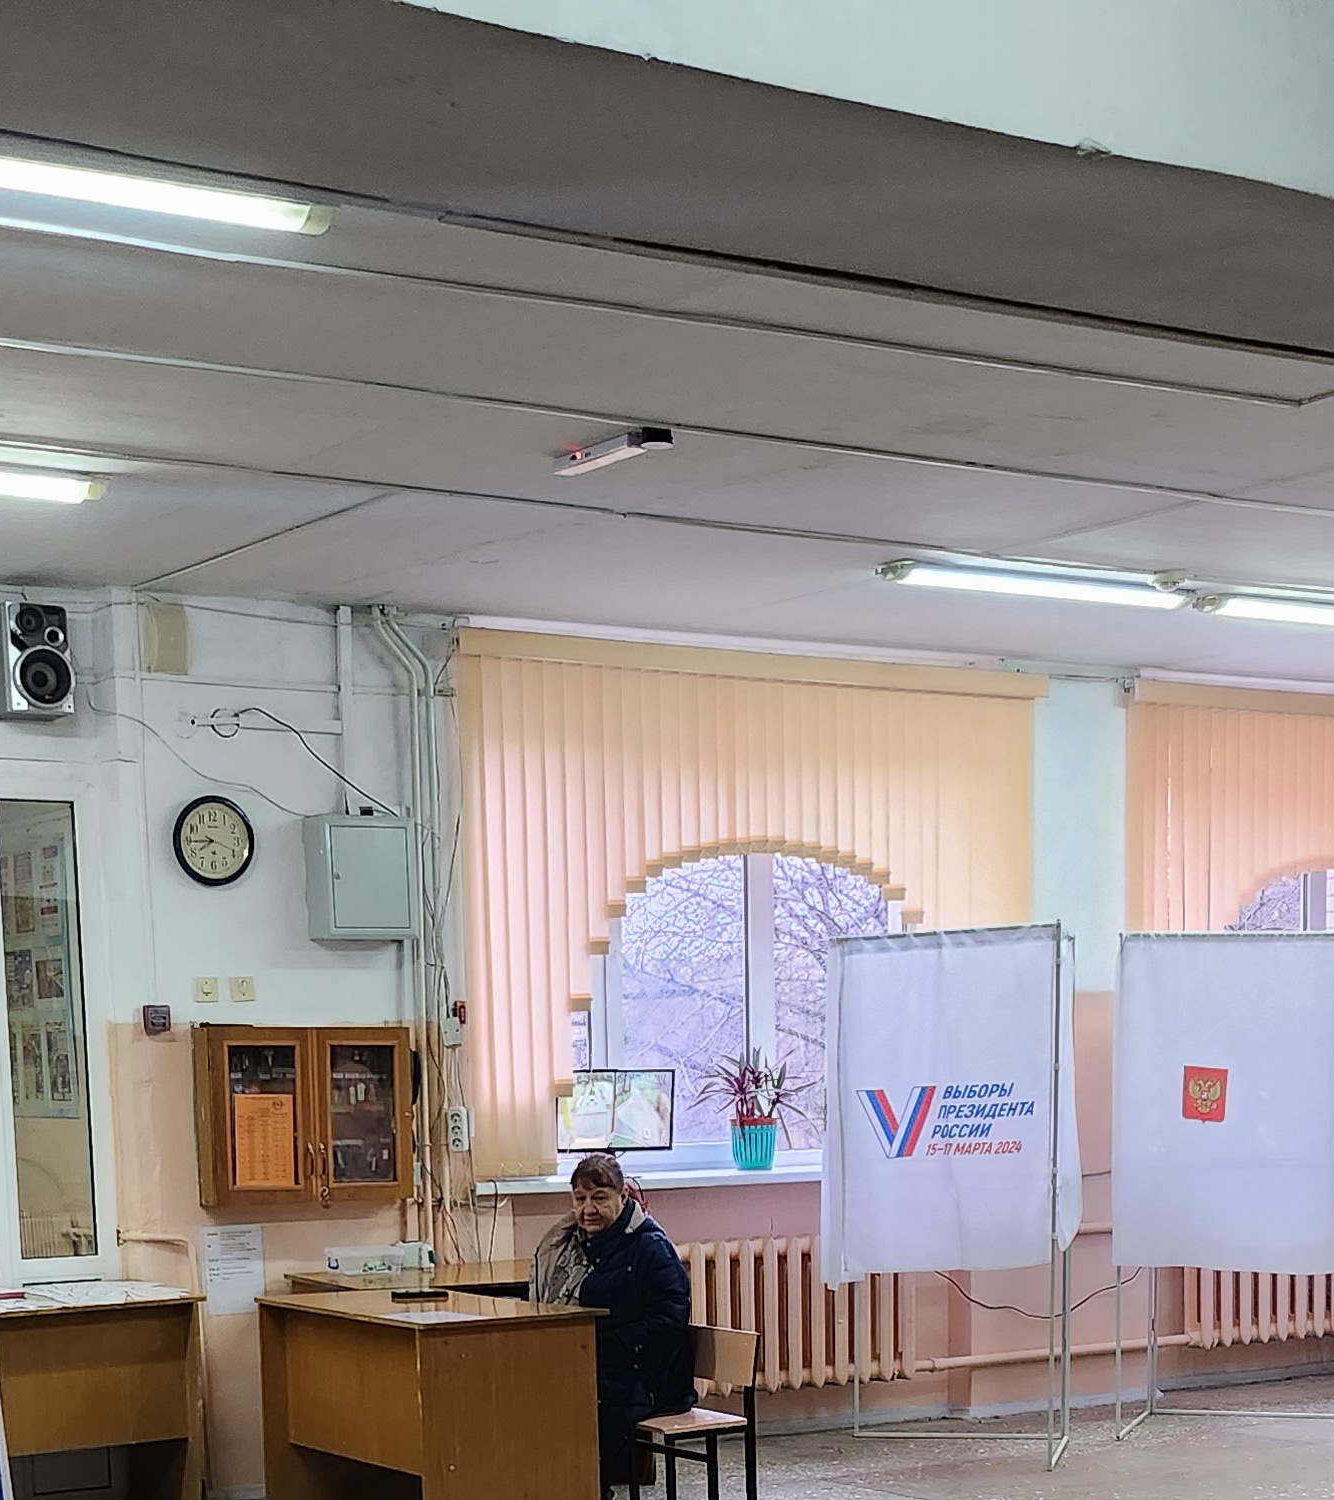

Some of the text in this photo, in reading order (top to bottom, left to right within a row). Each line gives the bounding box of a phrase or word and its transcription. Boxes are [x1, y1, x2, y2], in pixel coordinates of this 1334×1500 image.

[942, 1082, 1015, 1100] ВЫБОРЫ
[937, 1101, 1035, 1120] ПРЕЗИДЕНТА
[931, 1123, 993, 1139] РОССИИ
[953, 1142, 993, 1156] МАРТА
[994, 1140, 1022, 1155] 2024
